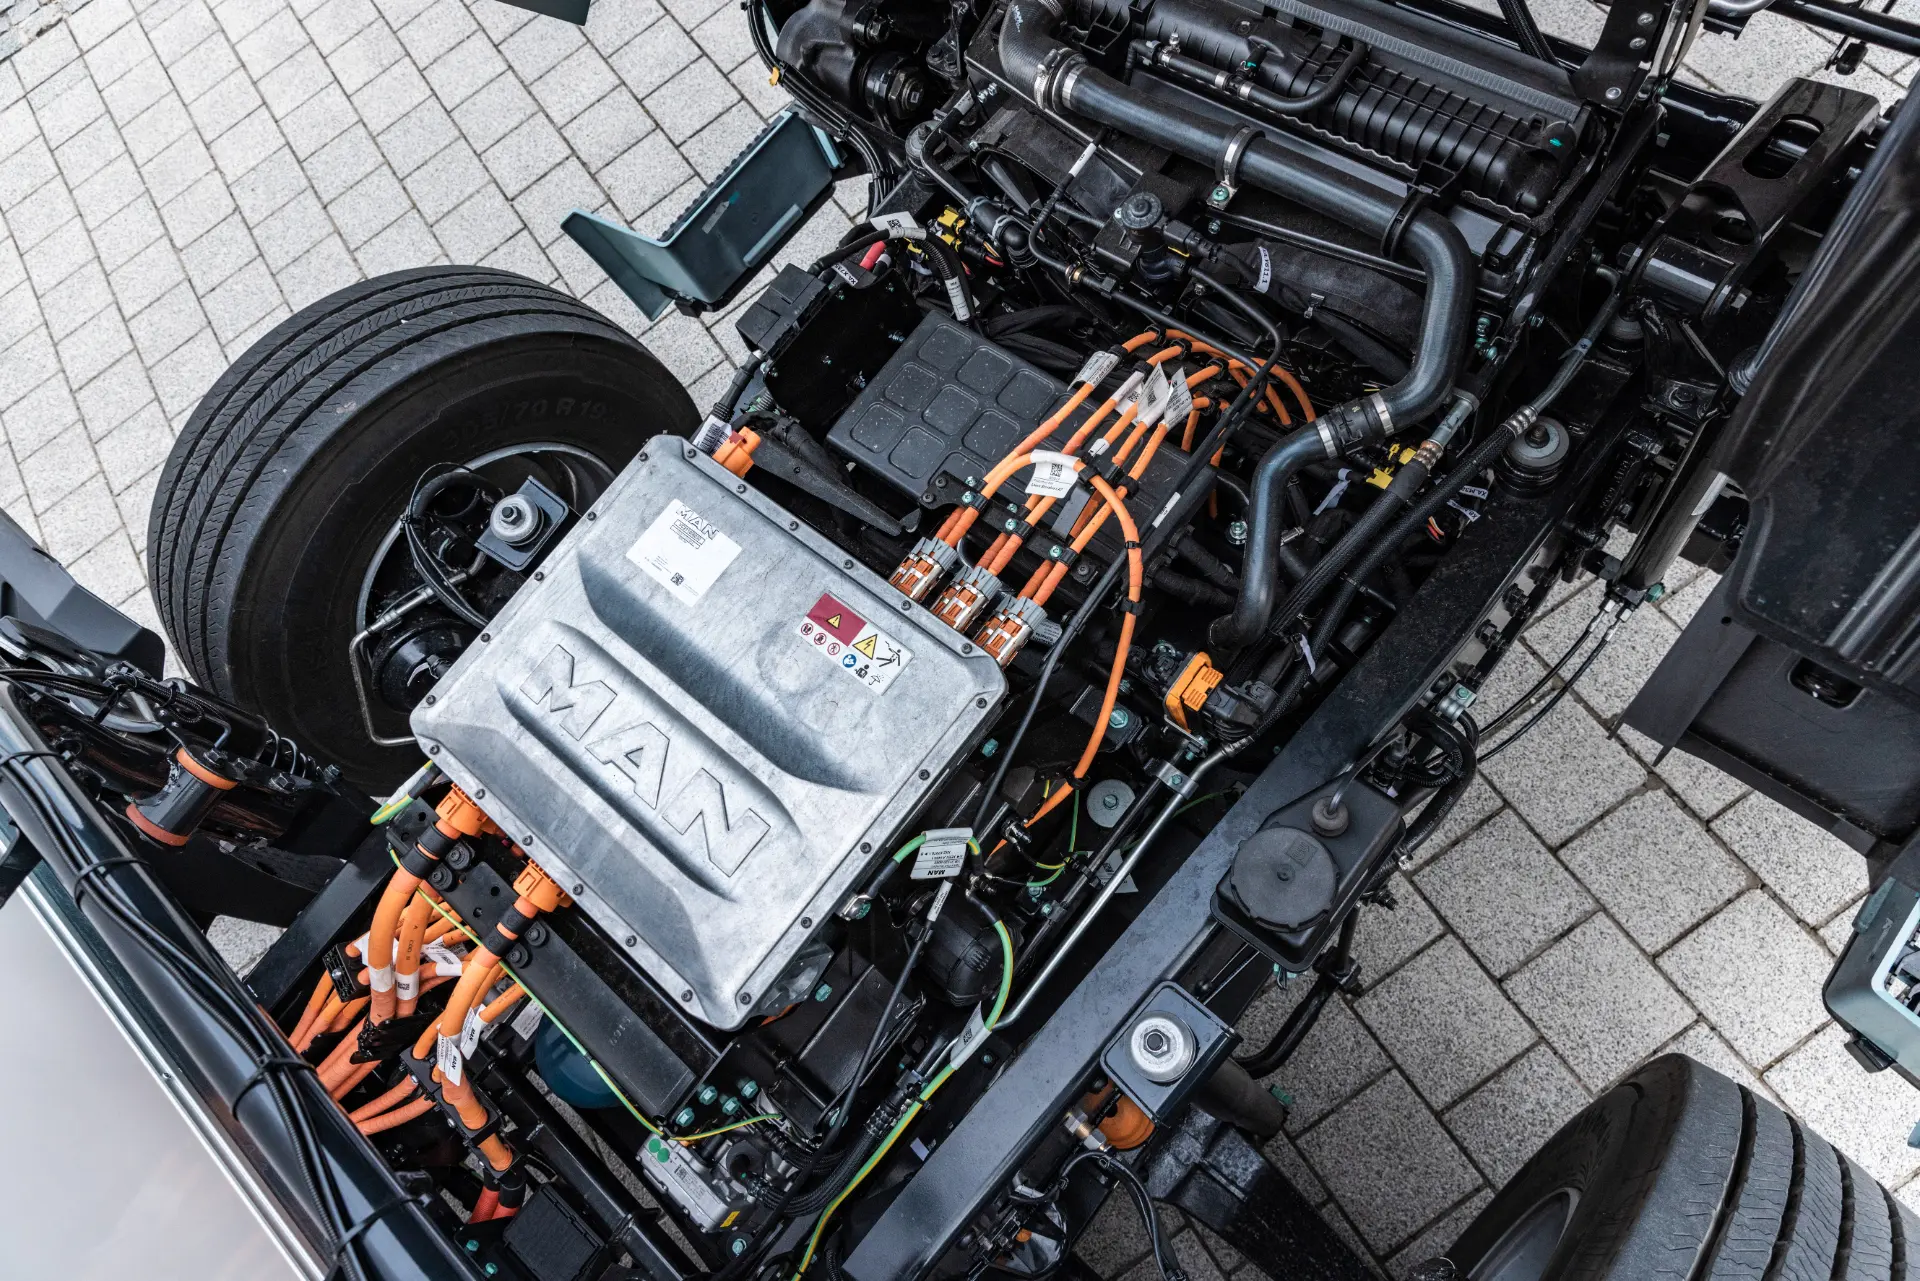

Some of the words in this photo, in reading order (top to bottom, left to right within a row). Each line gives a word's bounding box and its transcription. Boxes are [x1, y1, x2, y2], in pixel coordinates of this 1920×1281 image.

[555, 397, 577, 417] R
[675, 505, 720, 540] MAN
[519, 643, 771, 879] MAN
[926, 868, 946, 876] MAN
